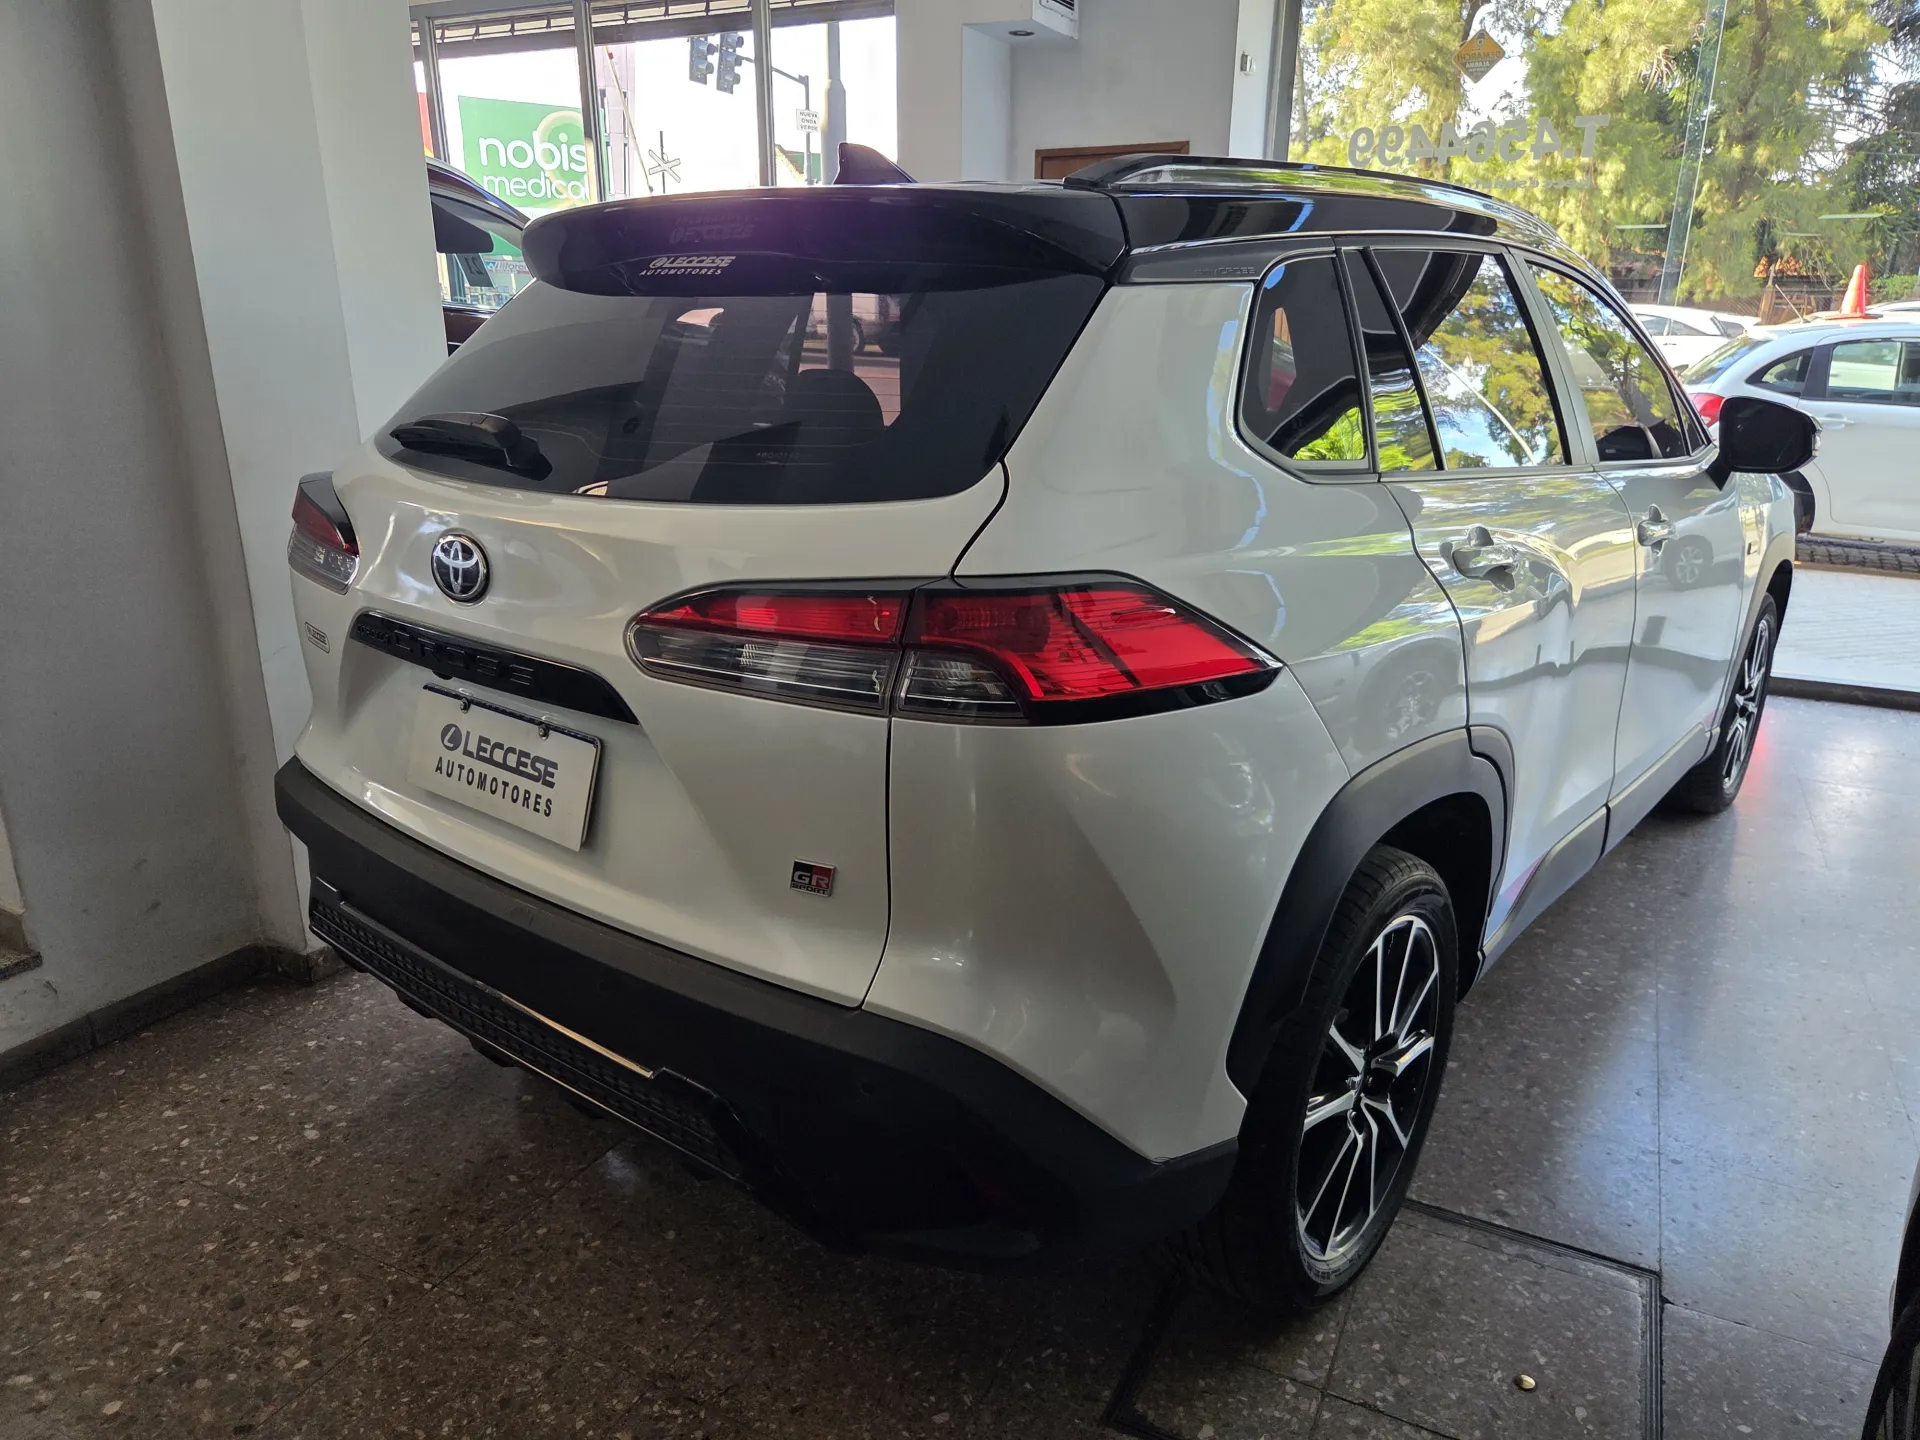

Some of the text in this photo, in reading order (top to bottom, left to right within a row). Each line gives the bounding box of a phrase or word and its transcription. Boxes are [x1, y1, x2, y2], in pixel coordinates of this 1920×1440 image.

[478, 130, 587, 172] nobis
[639, 268, 722, 276] AUTOMOTORES
[662, 256, 737, 268] LECCESE
[394, 630, 535, 686] CROSS
[462, 730, 559, 789] LECCESE
[435, 756, 553, 817] AUTOMOTORES
[791, 881, 828, 895] SPORT
[793, 870, 829, 889] GR
